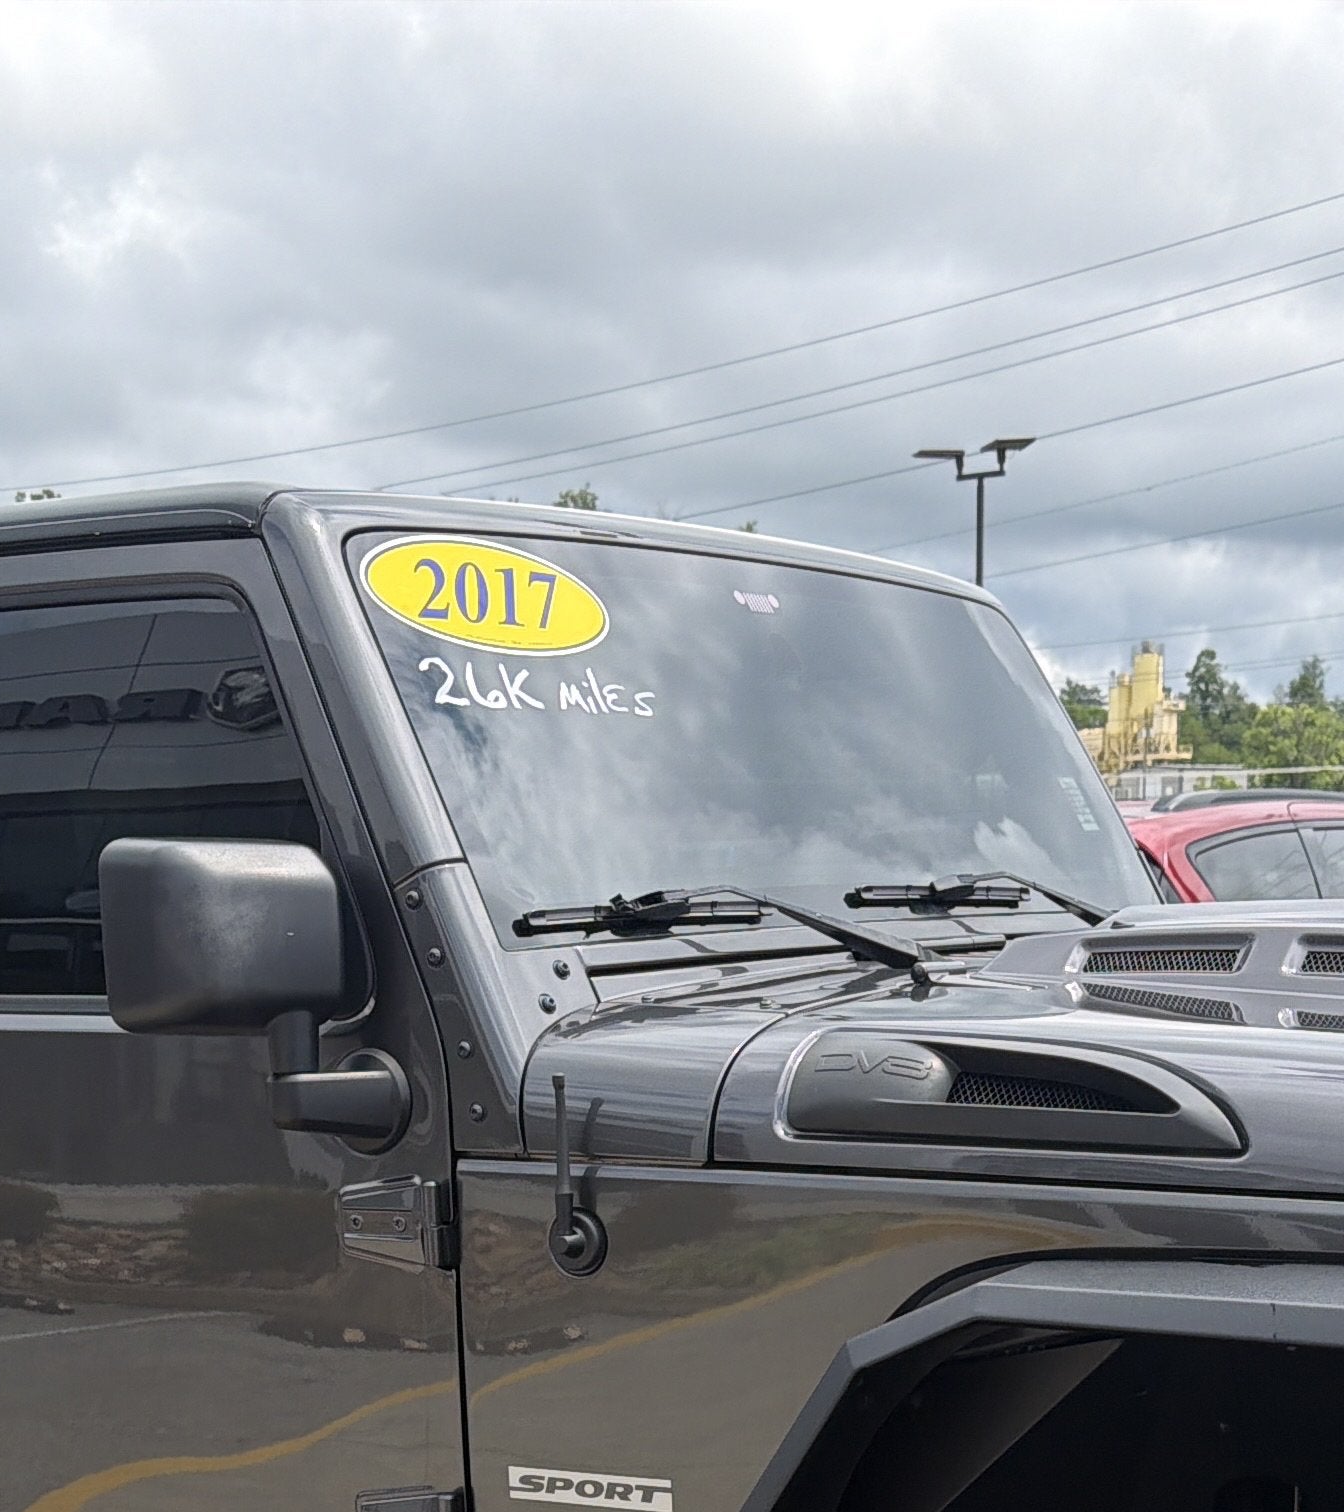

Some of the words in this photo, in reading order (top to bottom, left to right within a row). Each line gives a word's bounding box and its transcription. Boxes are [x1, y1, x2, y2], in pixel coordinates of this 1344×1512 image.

[414, 558, 557, 629] 2017
[418, 656, 545, 709] 26K
[512, 1474, 664, 1505] SPORT
